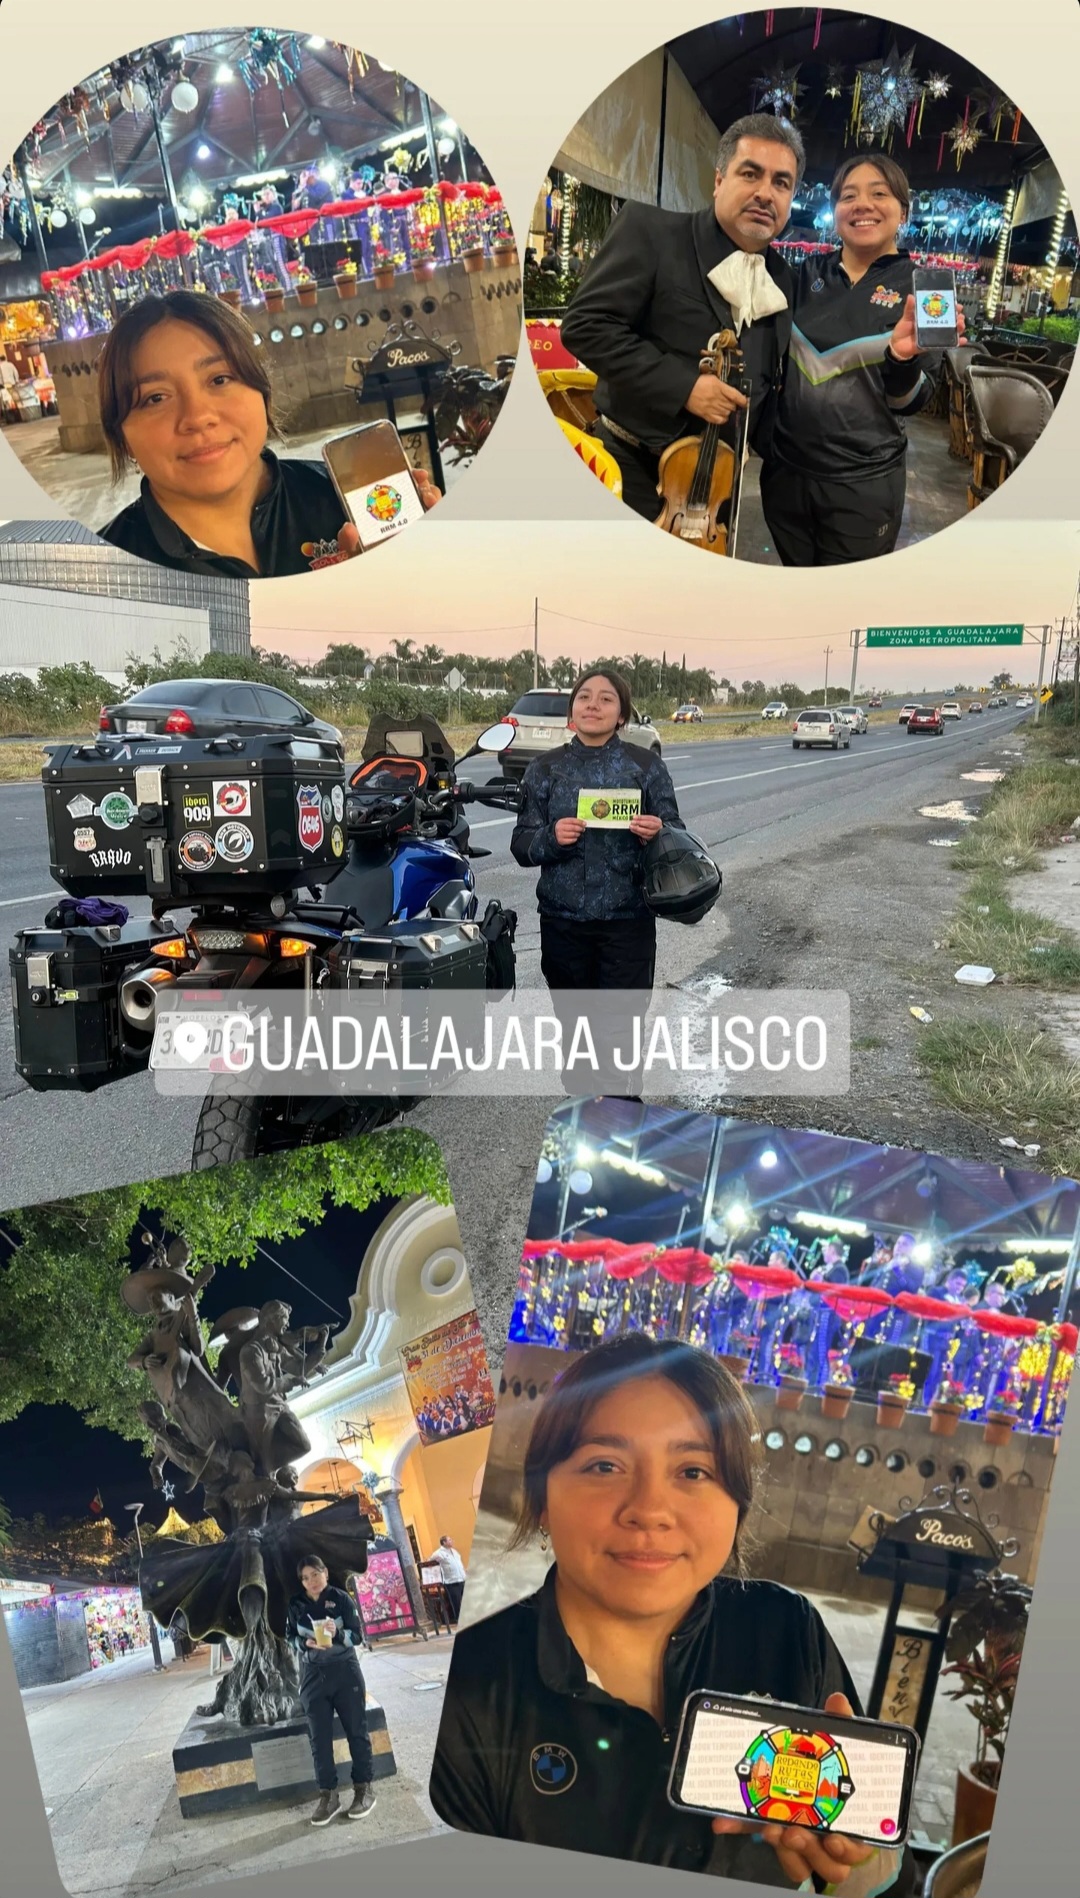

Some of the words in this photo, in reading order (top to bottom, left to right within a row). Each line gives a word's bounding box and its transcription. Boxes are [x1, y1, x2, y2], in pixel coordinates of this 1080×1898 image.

[387, 348, 430, 368] Paco's
[380, 522, 397, 534] RRM
[397, 518, 409, 528] 4.0
[870, 629, 930, 637] BIENVENIDOS
[947, 627, 1019, 636] GUADALAJARA
[919, 636, 997, 644] METROPOLITANA
[185, 796, 208, 806] ibero
[184, 806, 211, 822] 90.9
[612, 804, 639, 815] RRM
[89, 848, 131, 869] BRAVO
[421, 1350, 429, 1359] 31
[431, 1346, 440, 1355] de
[915, 1518, 974, 1549] Paco's
[888, 1638, 923, 1724] Bienv
[532, 1746, 567, 1761] BMW
